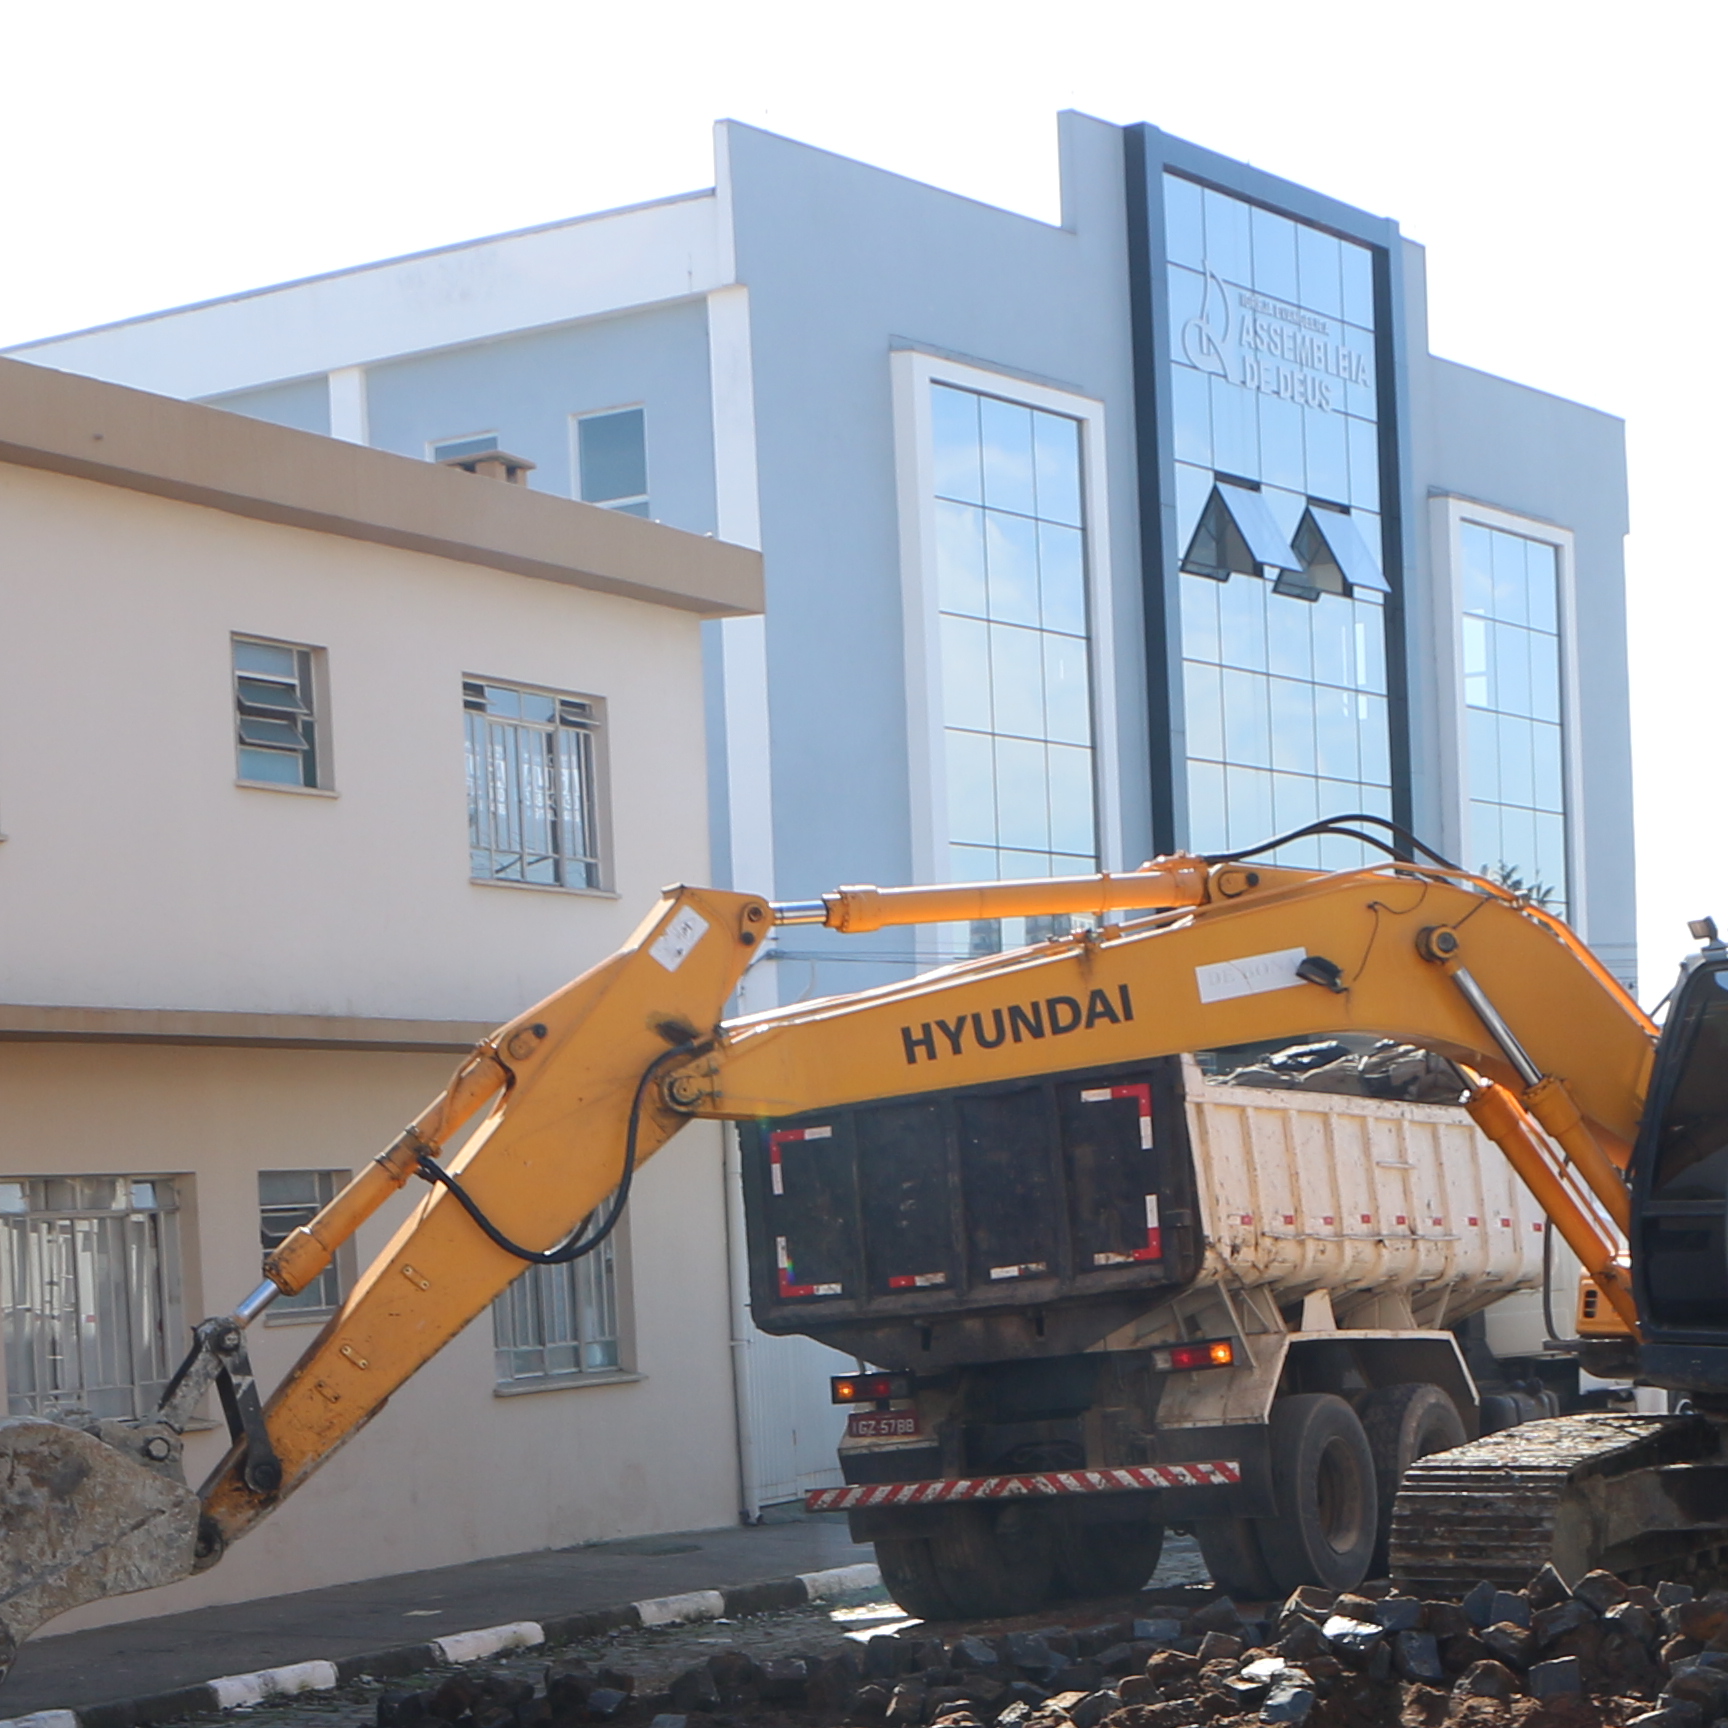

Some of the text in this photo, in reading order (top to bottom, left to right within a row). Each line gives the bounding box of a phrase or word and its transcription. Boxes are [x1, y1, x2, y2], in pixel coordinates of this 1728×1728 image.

[1239, 314, 1370, 388] ASSEMBLEIA
[1242, 354, 1333, 412] DE DEUS
[900, 983, 1134, 1065] HYUNDAI
